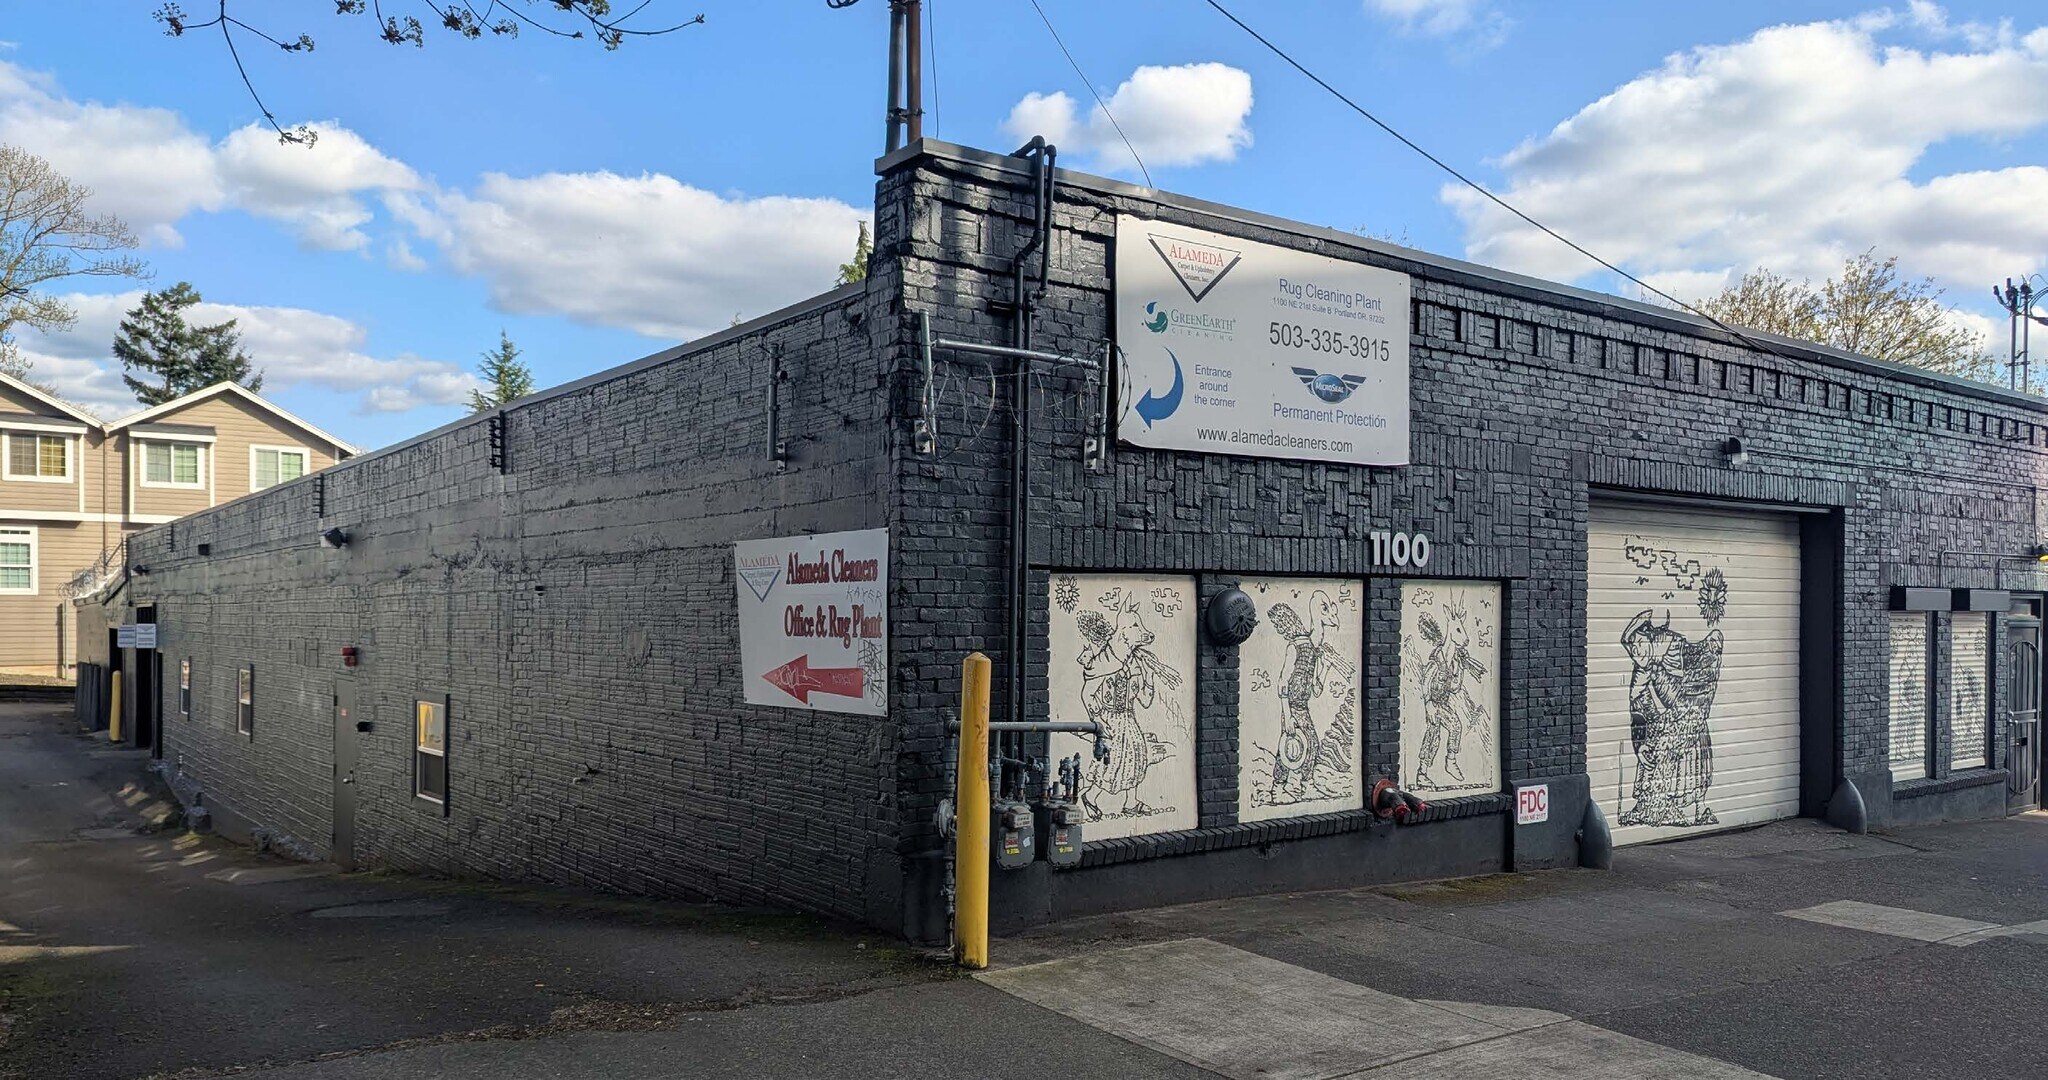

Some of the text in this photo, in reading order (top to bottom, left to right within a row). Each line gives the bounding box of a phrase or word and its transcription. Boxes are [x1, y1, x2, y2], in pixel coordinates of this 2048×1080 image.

[1169, 244, 1225, 267] ALAMEDA
[1280, 278, 1381, 311] Rug Cleaning Plant
[1273, 297, 1287, 306] 1100
[1288, 300, 1297, 308] NE
[1299, 301, 1310, 310] 21st
[1312, 304, 1326, 313] Suite
[1334, 308, 1356, 319] Portland
[1369, 314, 1385, 324] 97232
[1270, 322, 1390, 362] 503-335-3915
[1195, 364, 1232, 378] Entrance
[1199, 381, 1228, 393] around
[1194, 394, 1236, 408] the corner
[1273, 403, 1387, 429] Permanent Protection
[1197, 428, 1353, 452] www.alamedacleaners.com
[740, 554, 780, 567] ALAMEDA
[1370, 532, 1430, 567] 1100
[786, 549, 878, 585] Alameda Cleaners
[784, 604, 883, 649] Office & Rug Plant
[1520, 788, 1546, 814] FDC
